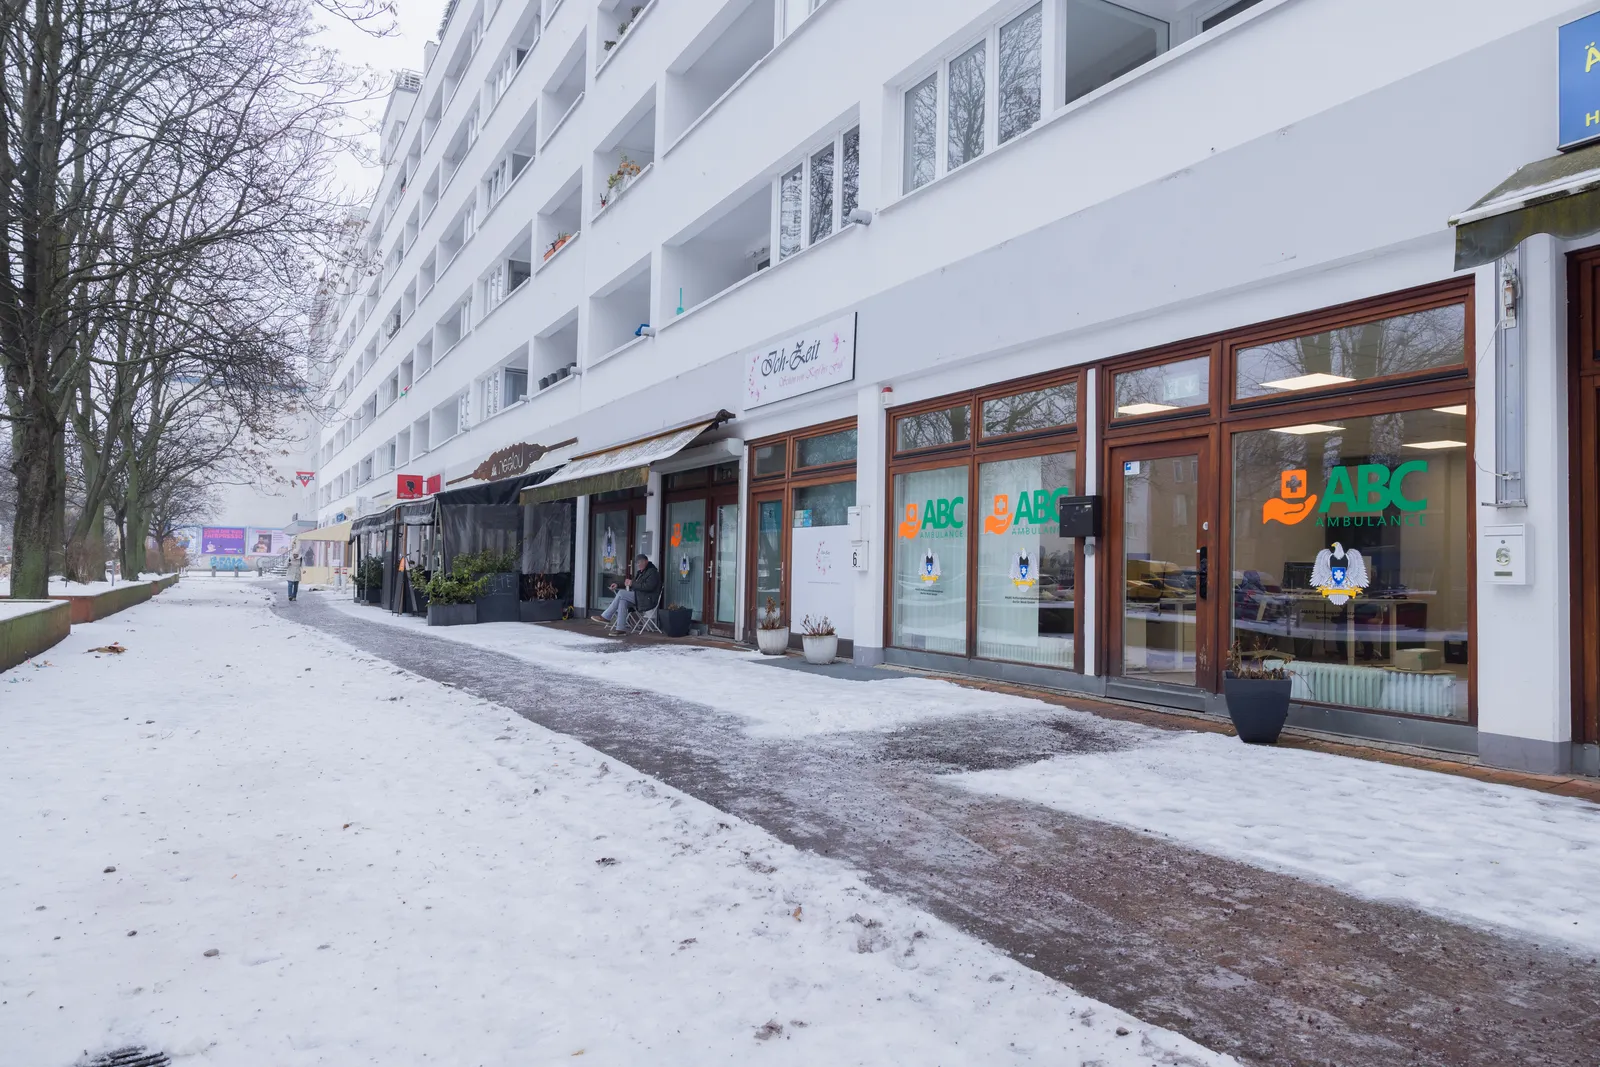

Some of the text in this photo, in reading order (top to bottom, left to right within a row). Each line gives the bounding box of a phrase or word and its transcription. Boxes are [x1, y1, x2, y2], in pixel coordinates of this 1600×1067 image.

[1318, 460, 1428, 513] ABC
[921, 496, 964, 531] ABC
[1013, 486, 1069, 526] ABC
[1011, 525, 1060, 536] AMBULAN
[1315, 514, 1427, 527] AMBULANCE
[682, 521, 701, 543] ABC
[920, 530, 964, 539] AMBULANCE
[852, 551, 858, 567] 6
[1496, 547, 1511, 567] 6
